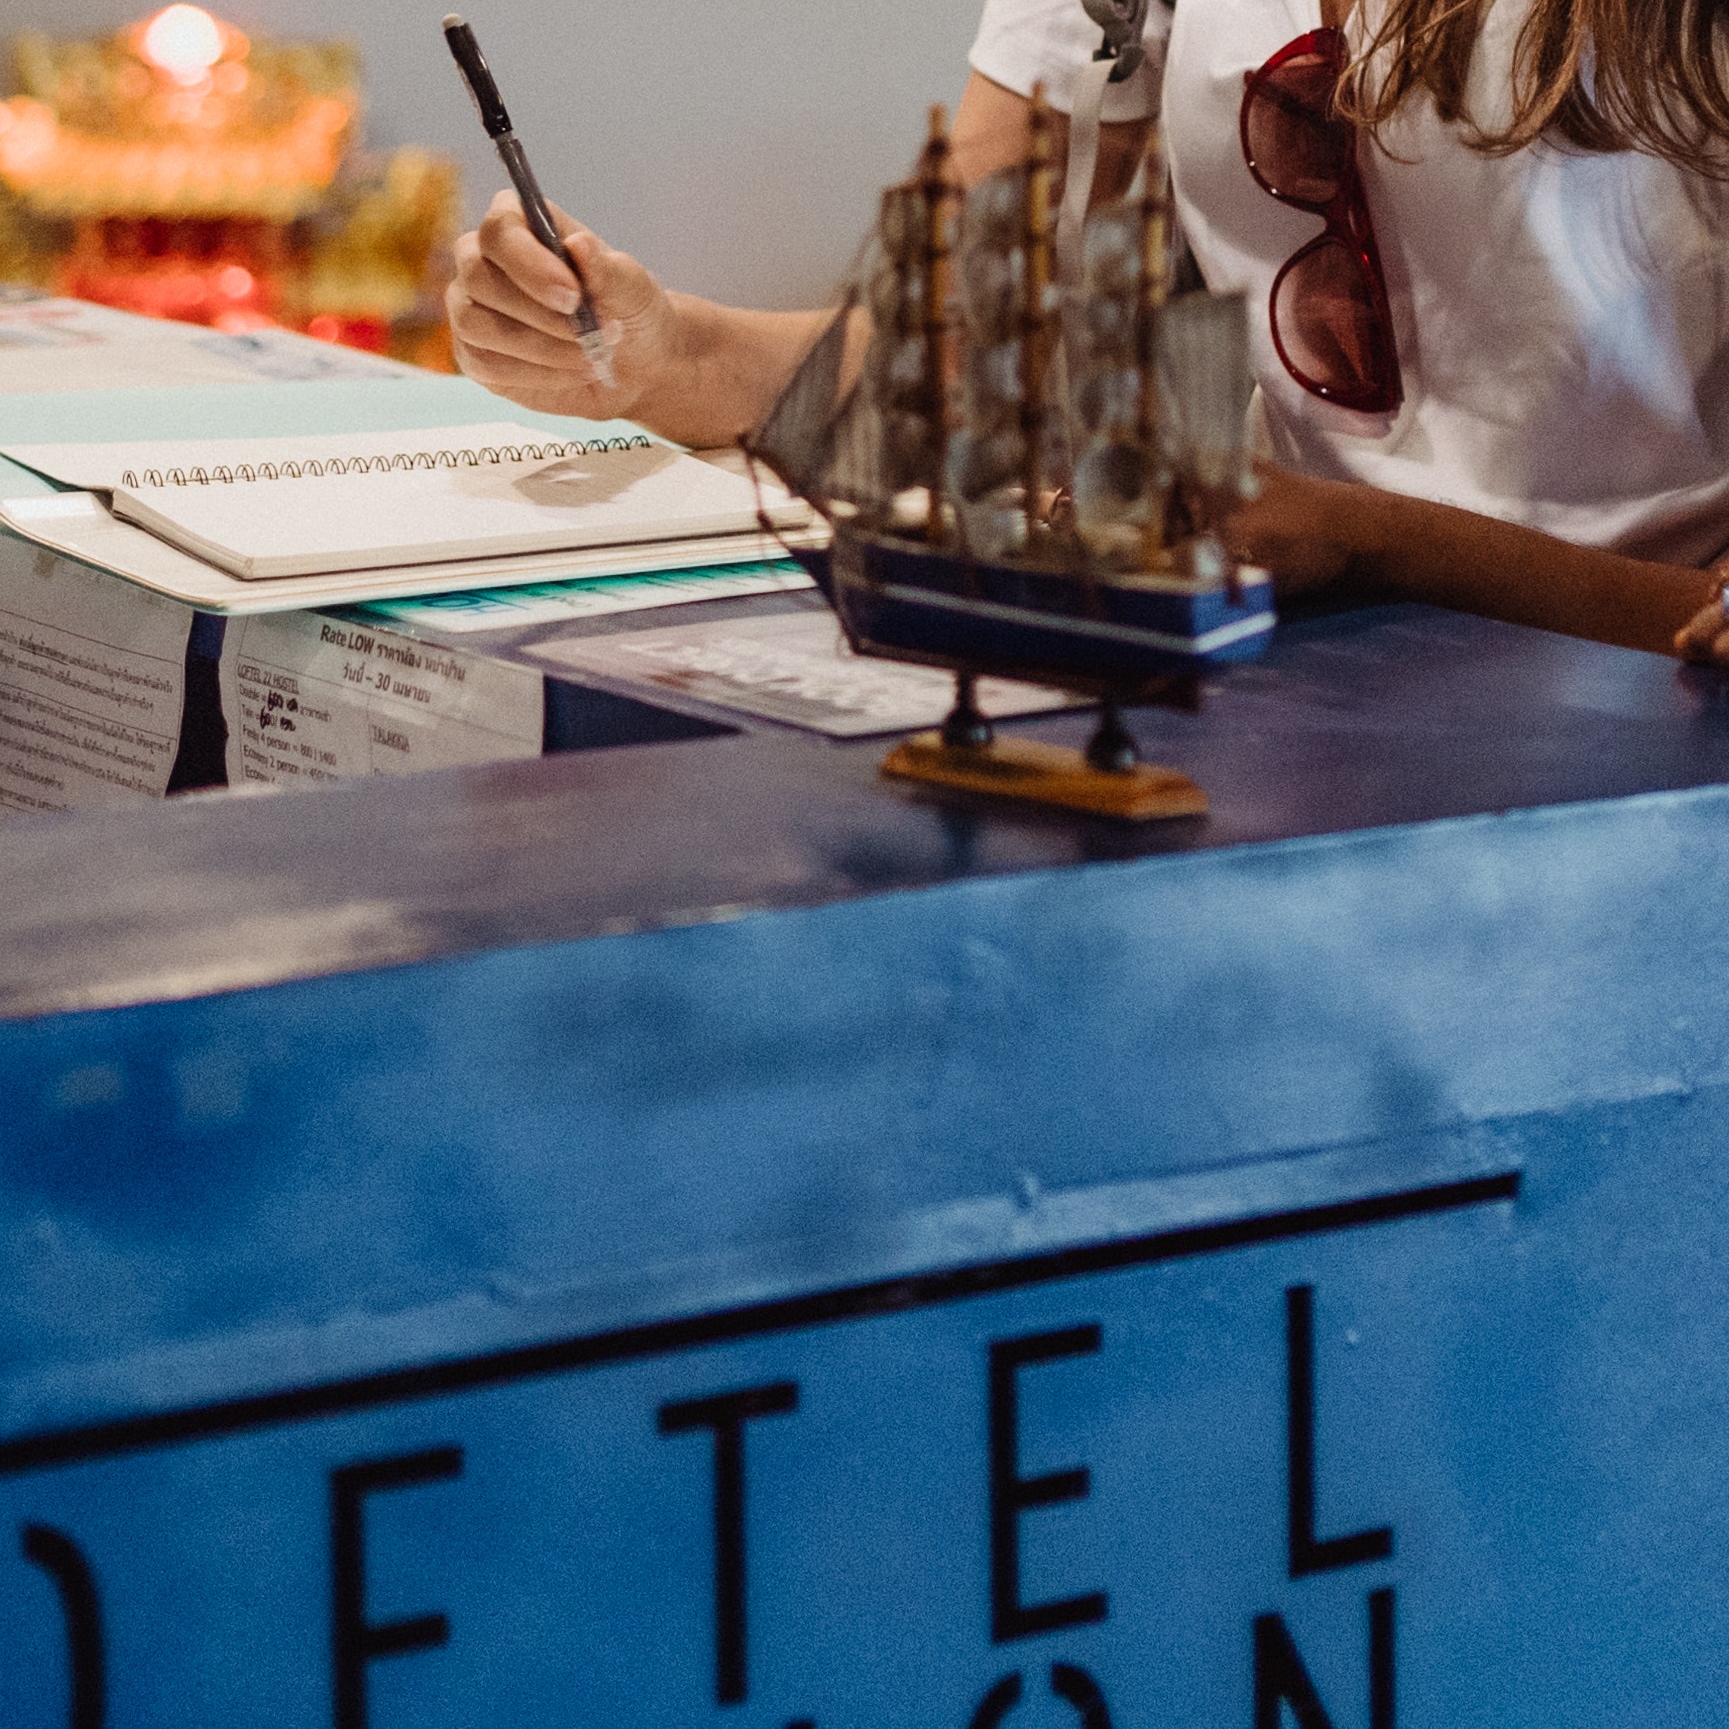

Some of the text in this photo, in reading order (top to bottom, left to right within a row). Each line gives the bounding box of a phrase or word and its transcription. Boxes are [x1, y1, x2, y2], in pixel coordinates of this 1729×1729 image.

[320, 624, 347, 650] Rate
[348, 631, 376, 655] LOW
[374, 671, 391, 692] 30
[266, 734, 291, 753] person
